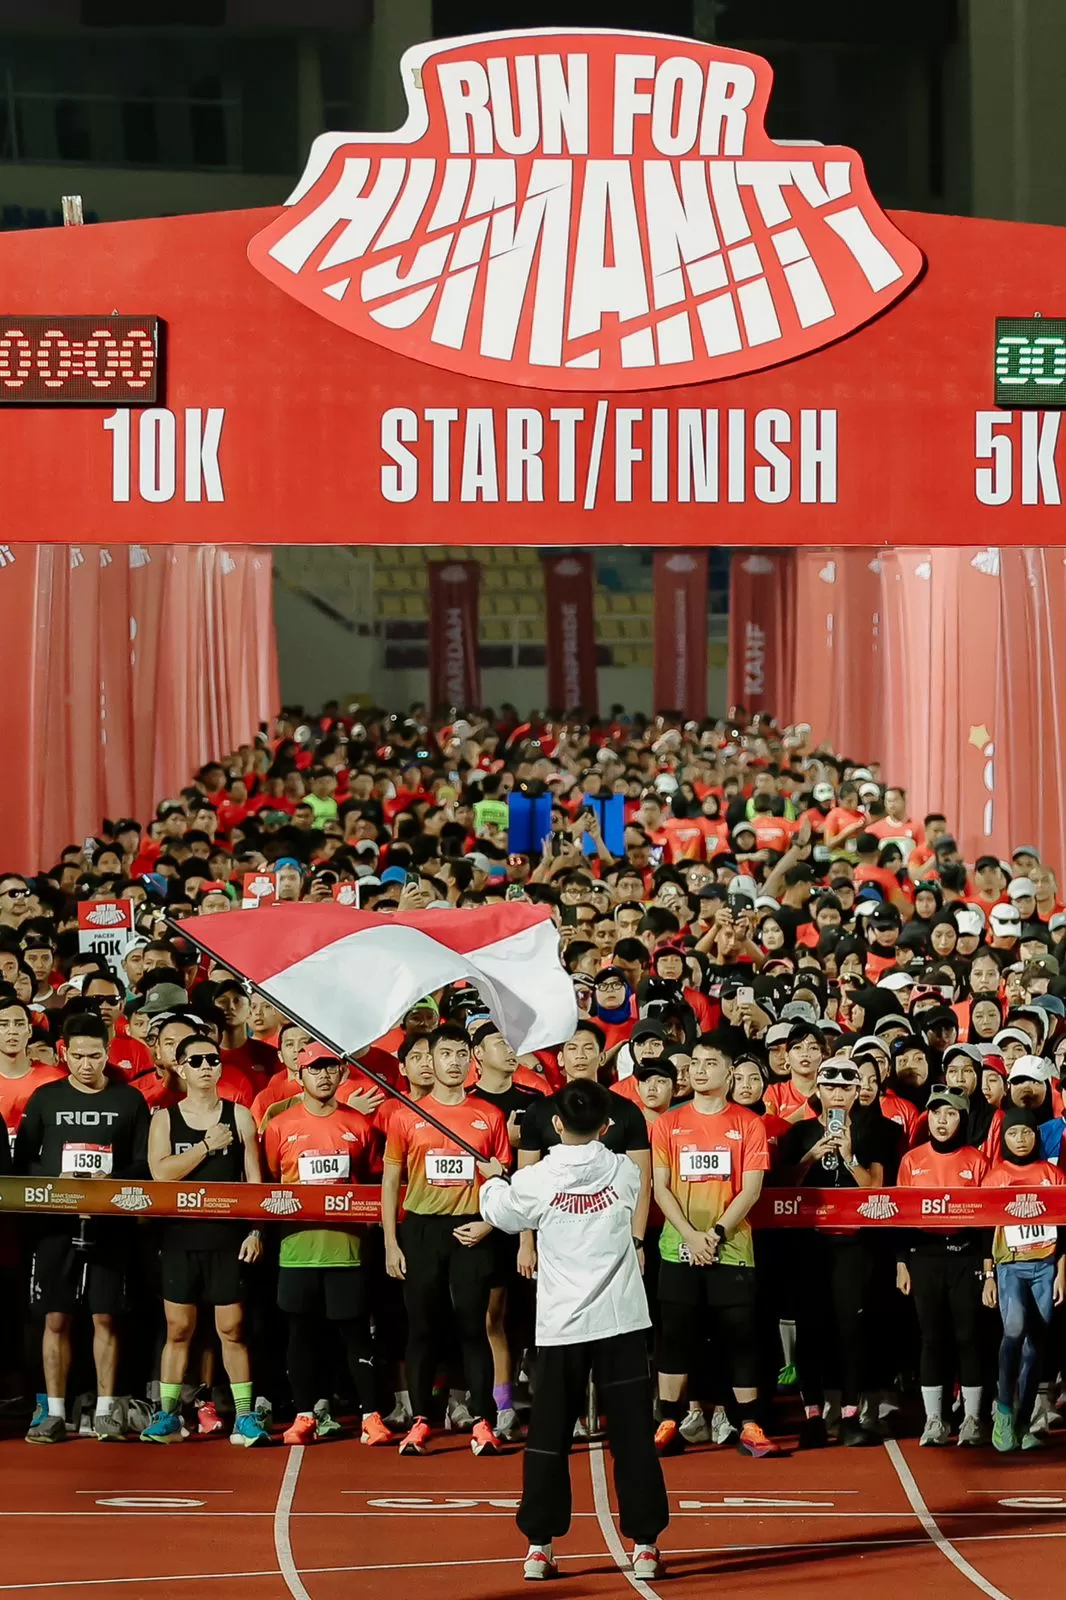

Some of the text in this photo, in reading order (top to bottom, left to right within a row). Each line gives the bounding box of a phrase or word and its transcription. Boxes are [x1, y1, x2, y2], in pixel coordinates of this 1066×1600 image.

[437, 53, 756, 156] RUN FOR
[268, 158, 904, 369] HUMANITY
[103, 408, 225, 503] 10K
[380, 400, 838, 510] START/FINISH
[974, 410, 1061, 506] 5K
[744, 621, 765, 695] KAHF
[88, 940, 122, 956] 10K
[56, 1111, 119, 1126] RIOT
[73, 1153, 102, 1169] 1538
[310, 1158, 340, 1175] 1064
[434, 1159, 463, 1174] 1823
[689, 1154, 719, 1170] 1898
[24, 1187, 49, 1203] BSI
[176, 1192, 201, 1208] BSI
[324, 1196, 349, 1211] BSI
[774, 1201, 797, 1215] BSI
[921, 1199, 946, 1214] BSI
